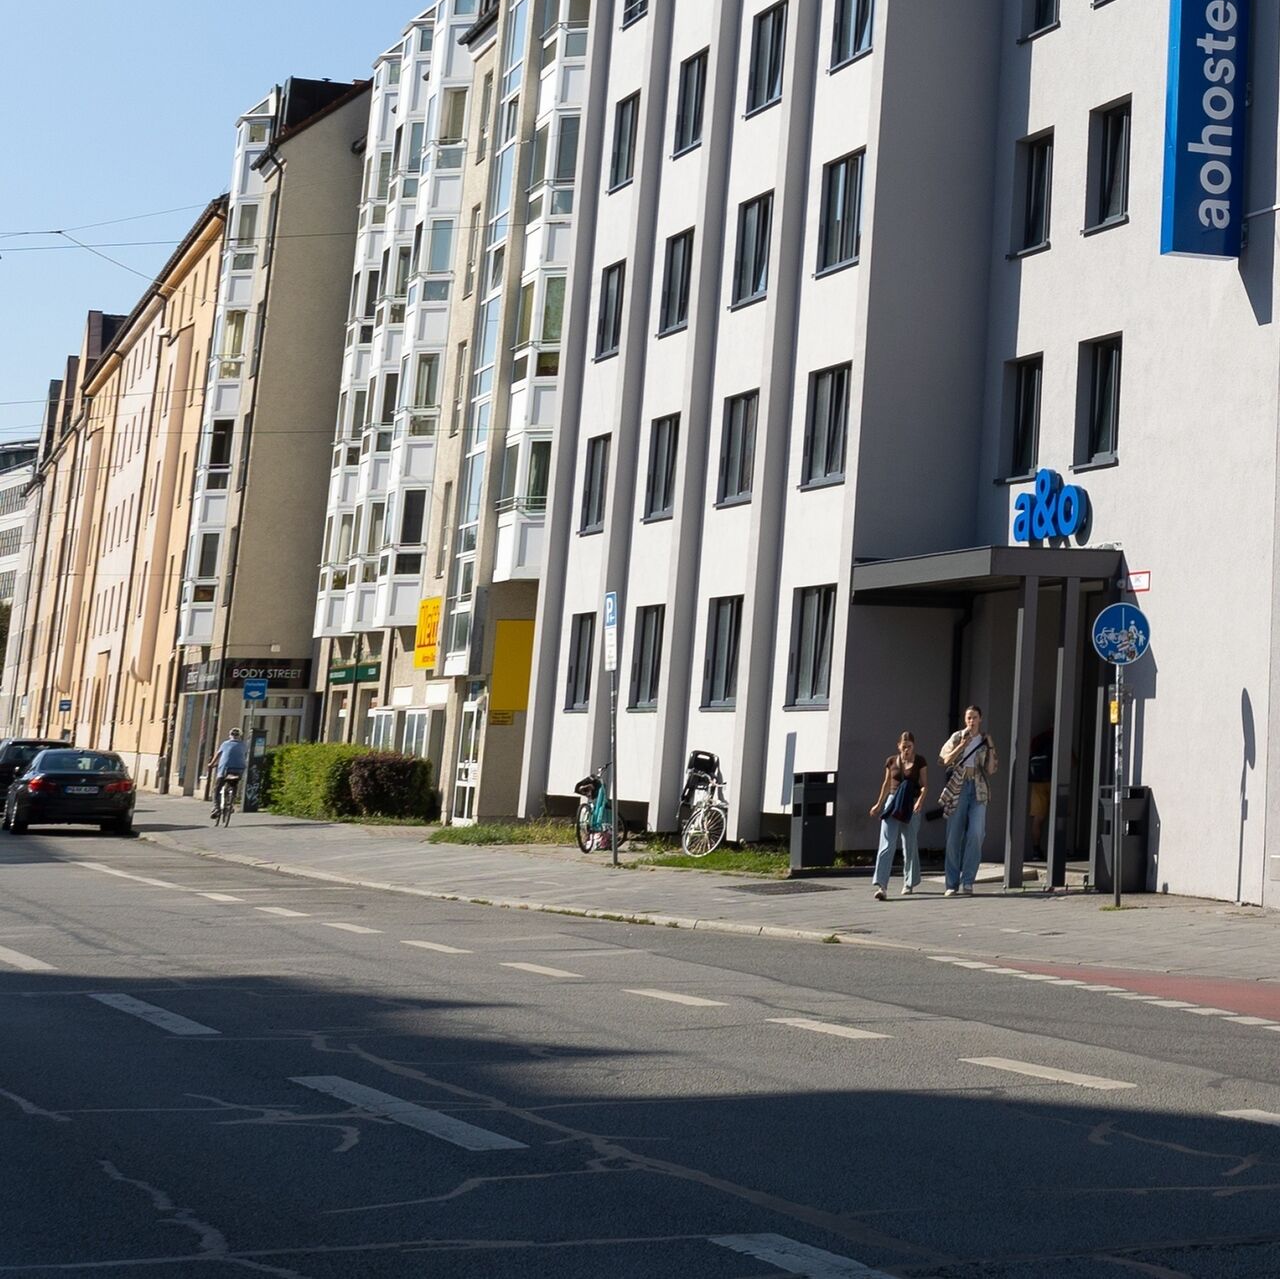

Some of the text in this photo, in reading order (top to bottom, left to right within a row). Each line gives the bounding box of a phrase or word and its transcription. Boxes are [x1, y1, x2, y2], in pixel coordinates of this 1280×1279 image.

[1013, 468, 1085, 542] a&o
[232, 668, 302, 679] BODY STREET
